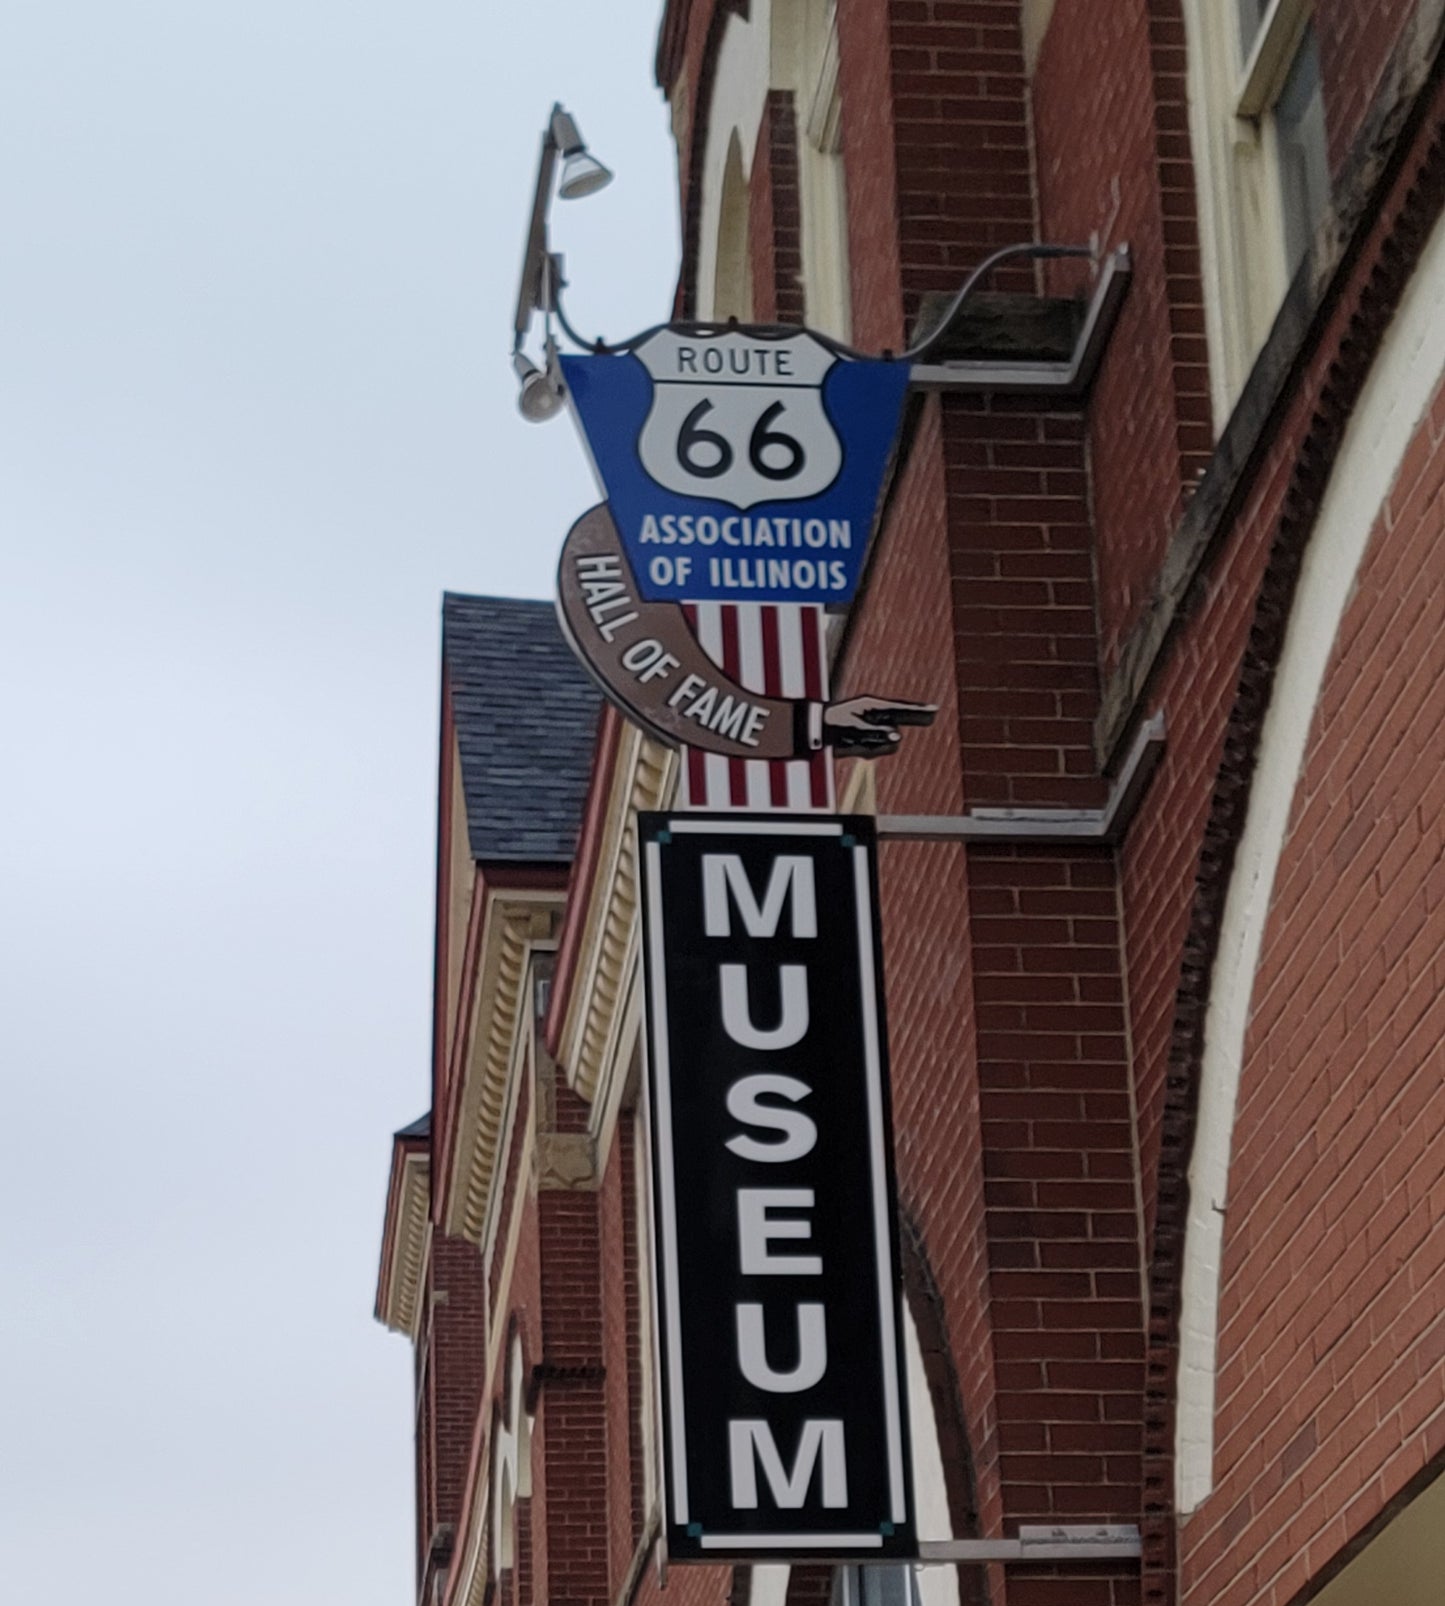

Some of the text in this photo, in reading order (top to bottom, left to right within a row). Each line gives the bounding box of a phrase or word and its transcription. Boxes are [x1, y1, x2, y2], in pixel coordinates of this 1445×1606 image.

[678, 346, 794, 377] ROUTE
[676, 397, 806, 481] 66
[639, 514, 852, 549] ASSOCIATION
[649, 557, 847, 590] OF ILLINOIS
[575, 553, 771, 747] HALL OF FAME
[702, 853, 849, 1510] MUSEUM
